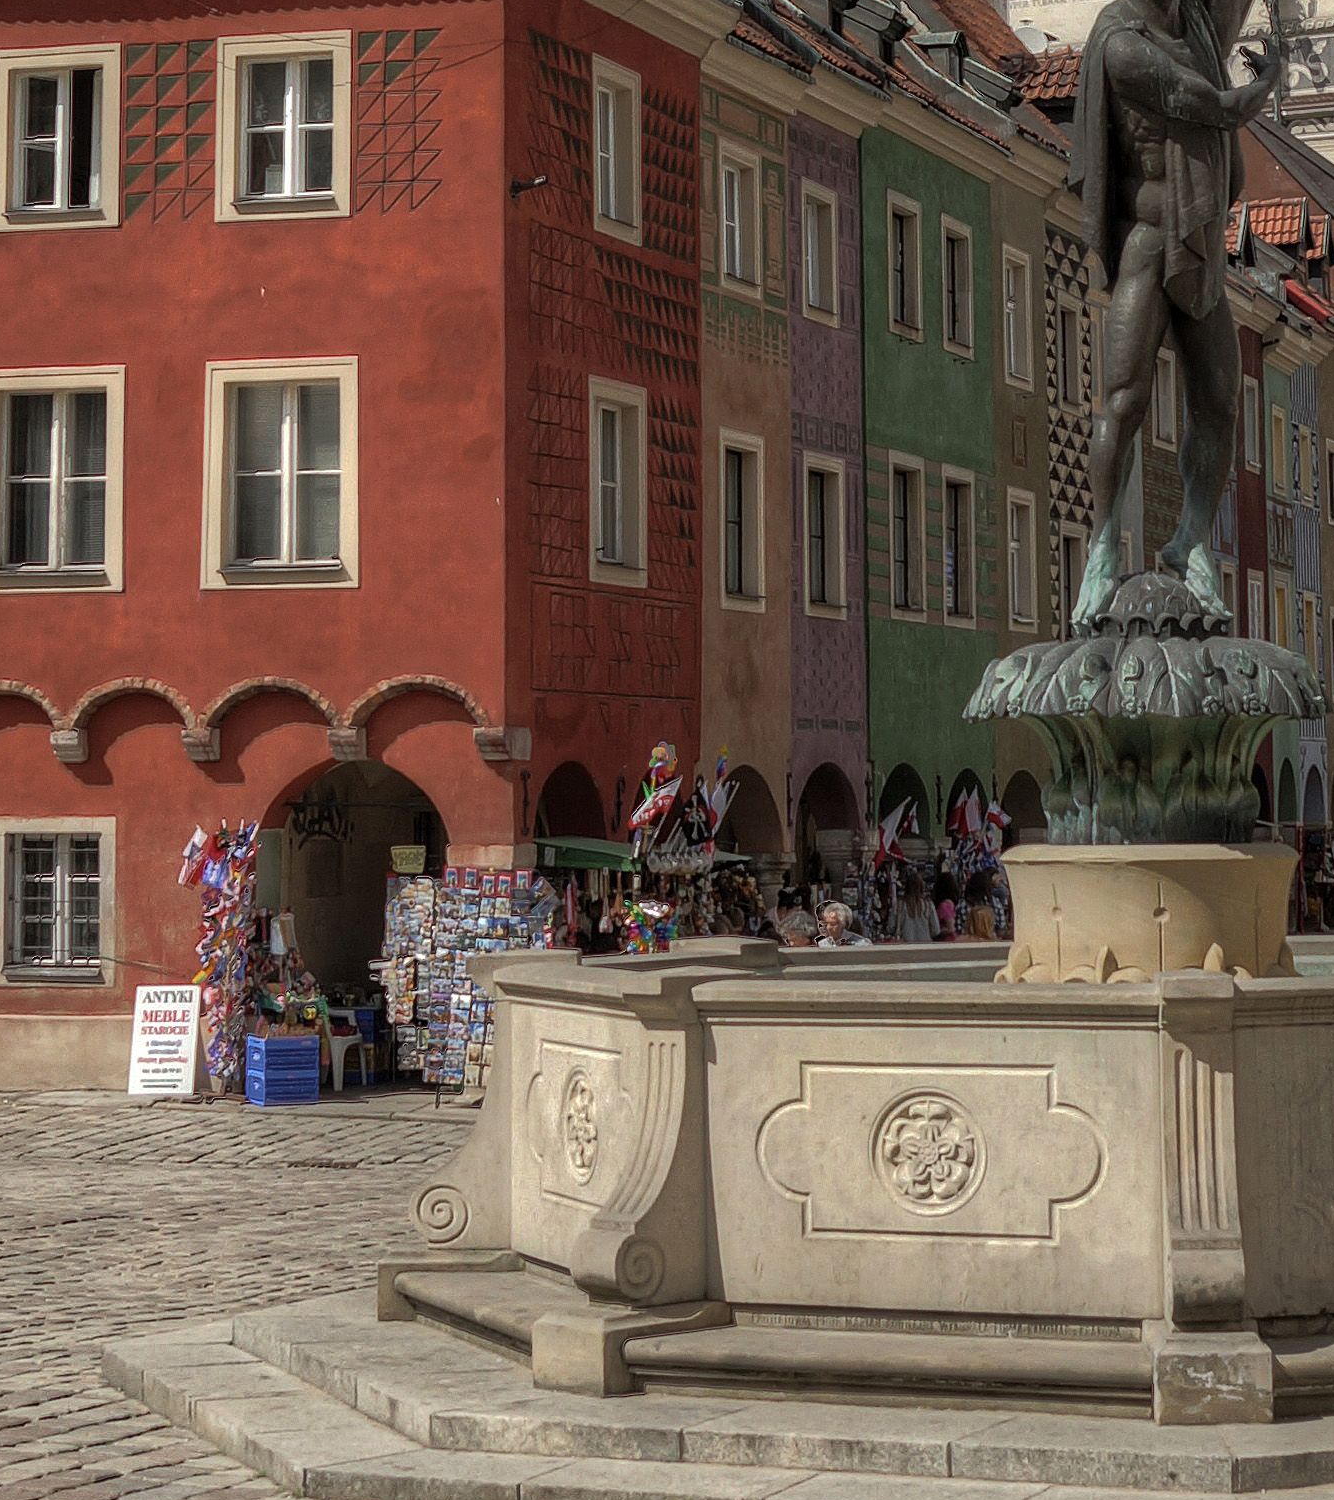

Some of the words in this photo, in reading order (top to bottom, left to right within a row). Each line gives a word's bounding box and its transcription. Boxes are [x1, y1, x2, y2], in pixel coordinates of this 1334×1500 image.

[142, 990, 194, 1004] ANTYKI
[141, 1009, 191, 1023] MEBLE
[140, 1026, 190, 1036] STAROCIE
